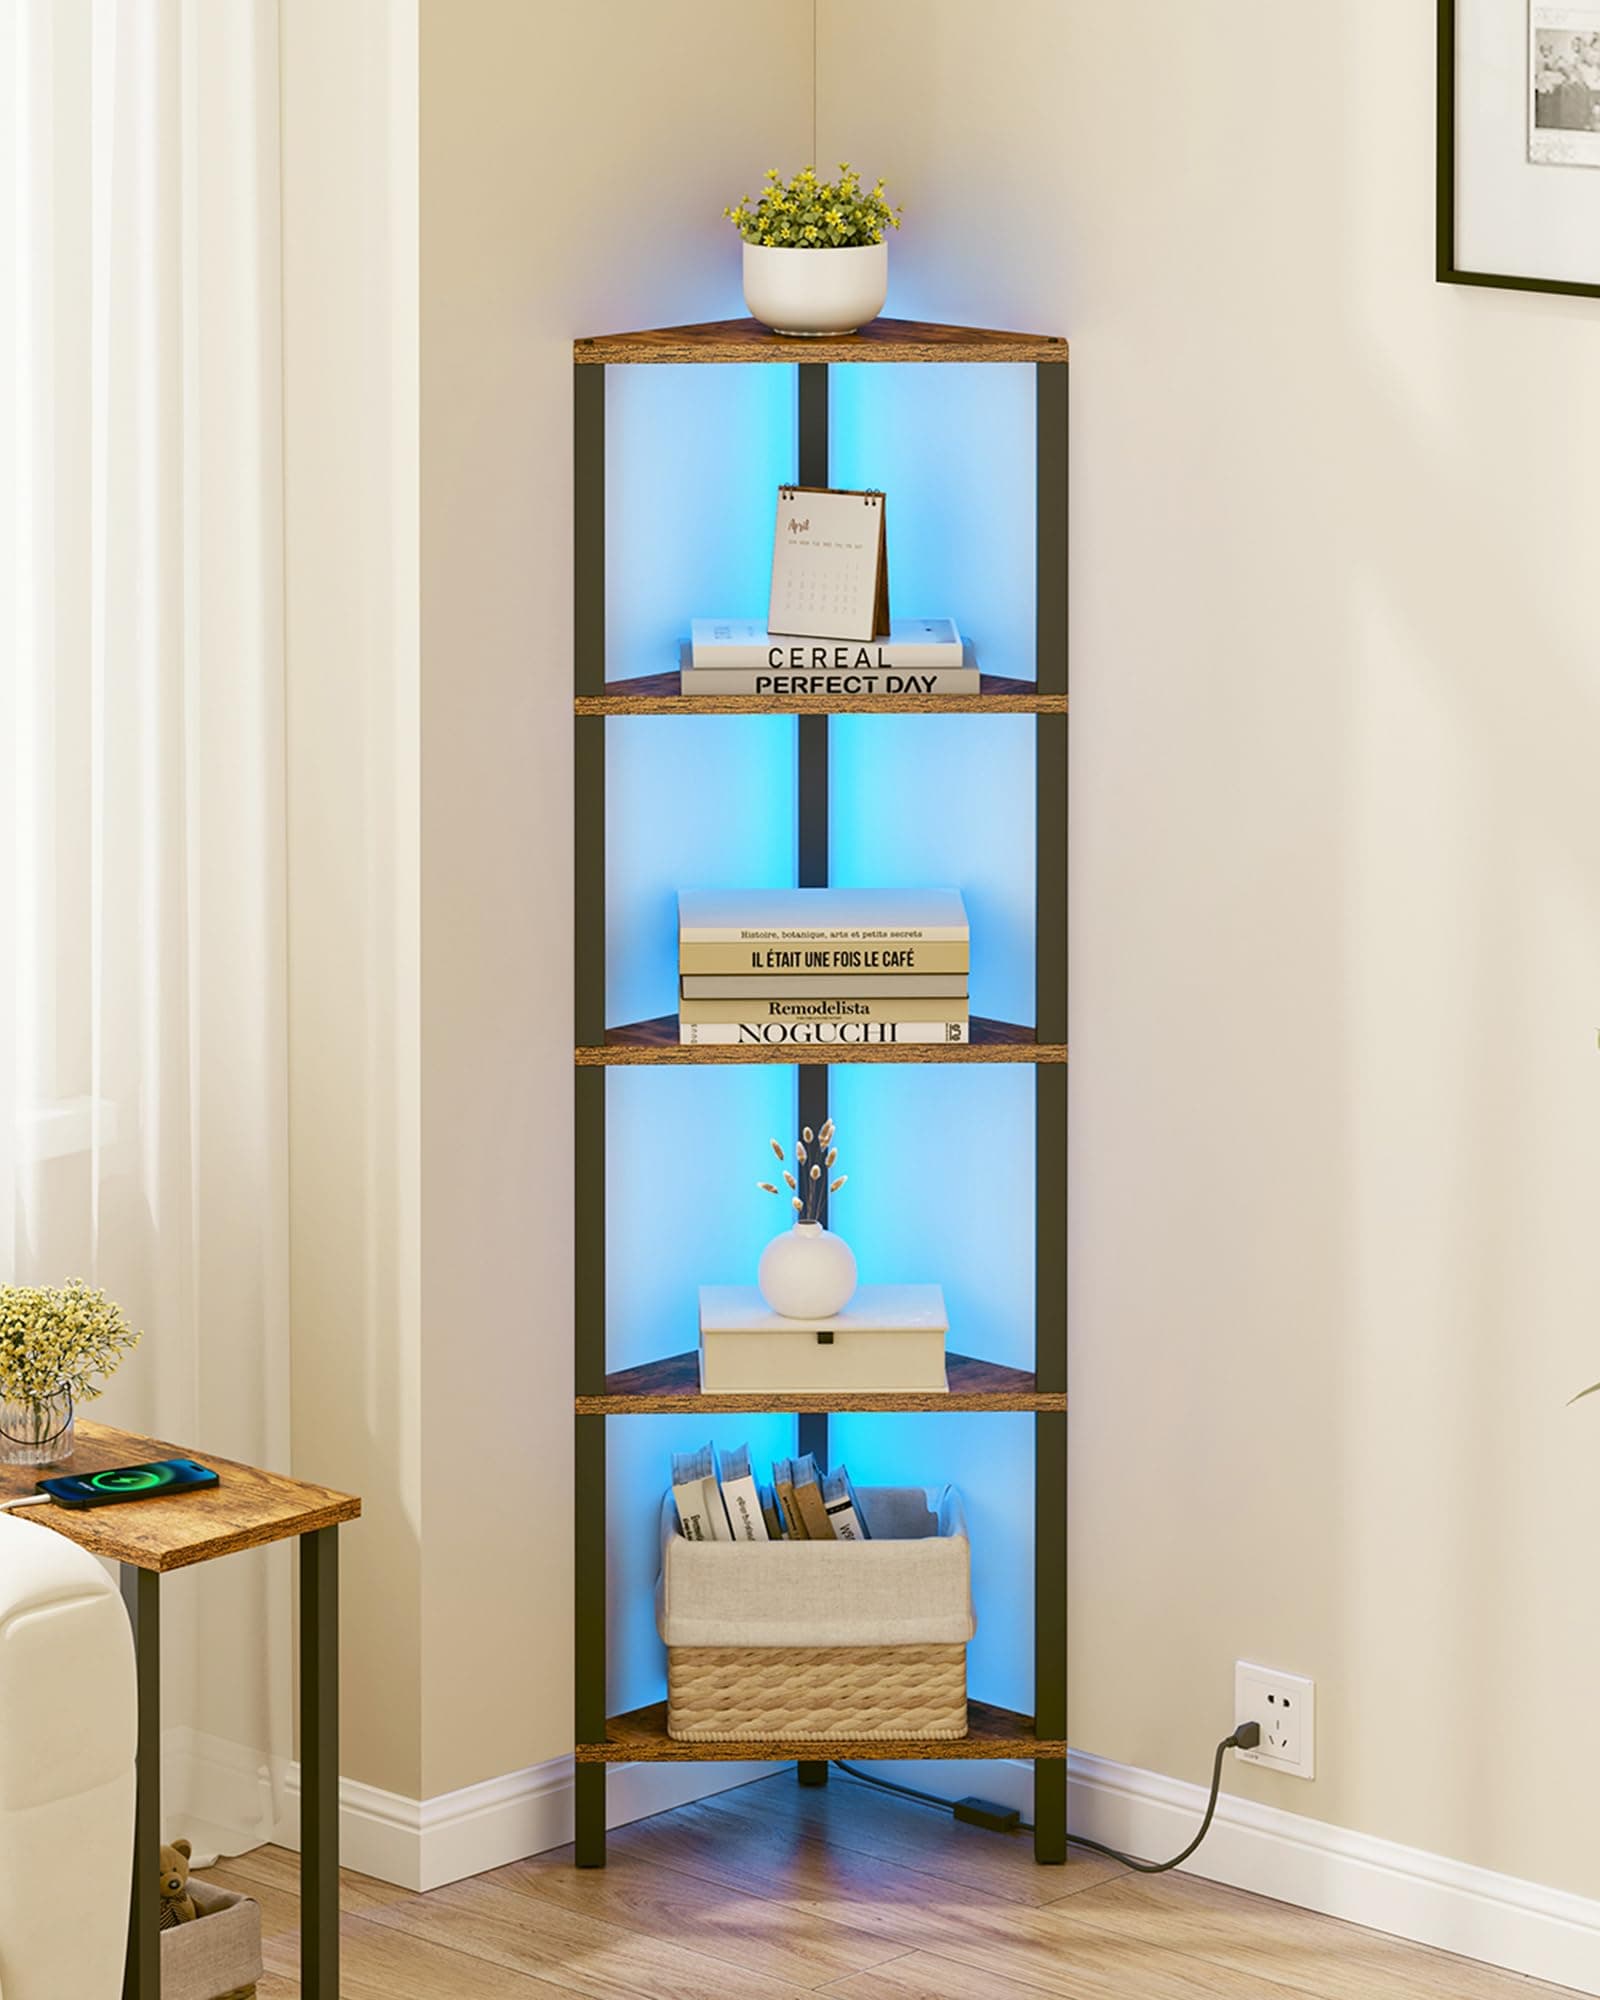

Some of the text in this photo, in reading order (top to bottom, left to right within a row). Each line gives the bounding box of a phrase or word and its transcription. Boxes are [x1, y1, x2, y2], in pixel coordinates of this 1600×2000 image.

[787, 518, 810, 534] April
[768, 647, 892, 669] CEREAL
[755, 675, 938, 694] PERFECT DAY
[740, 930, 923, 940] Histoire, botanique, arts et petits secrets
[751, 947, 915, 968] IL ÉTAIT UNE FOIS LE CAFÉ
[768, 1001, 870, 1016] Remodelista
[738, 1022, 899, 1044] NOGUCHI
